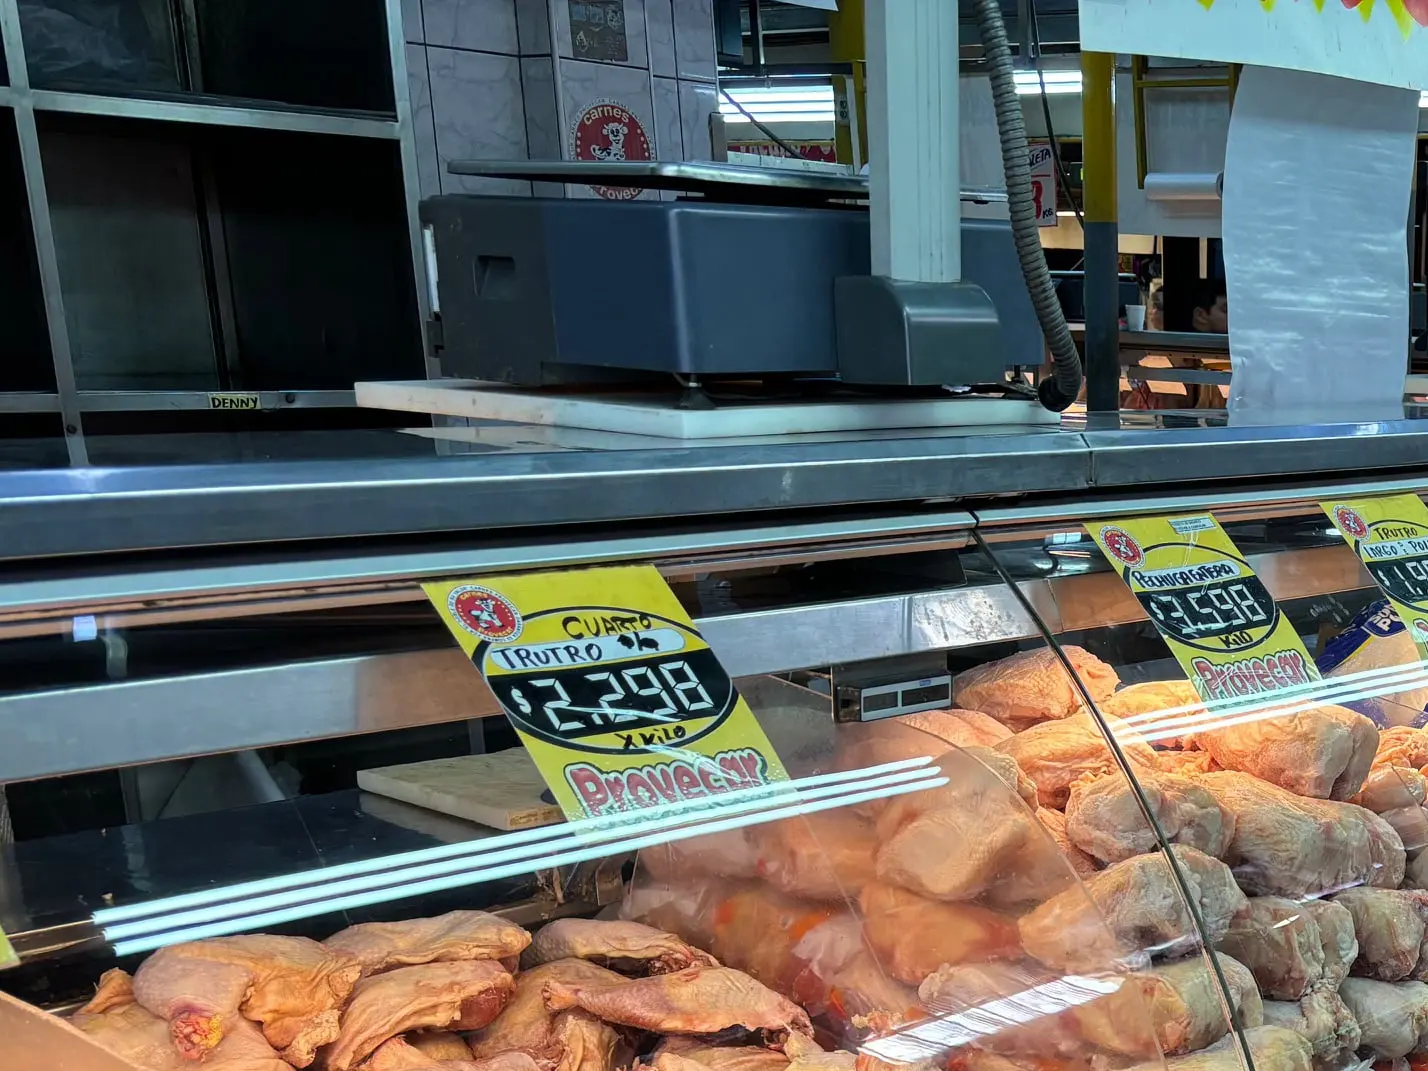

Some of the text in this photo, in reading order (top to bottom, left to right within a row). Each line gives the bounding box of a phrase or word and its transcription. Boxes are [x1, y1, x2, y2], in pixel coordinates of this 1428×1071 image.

[584, 106, 629, 125] carnes
[211, 396, 258, 409] DENNY
[1373, 526, 1418, 541] TRUTRO
[1362, 544, 1398, 558] LARGO
[561, 614, 652, 641] CUARTO
[492, 643, 603, 670] TRUTRO
[1191, 650, 1306, 701] Provecar
[566, 748, 766, 819] Provecar
